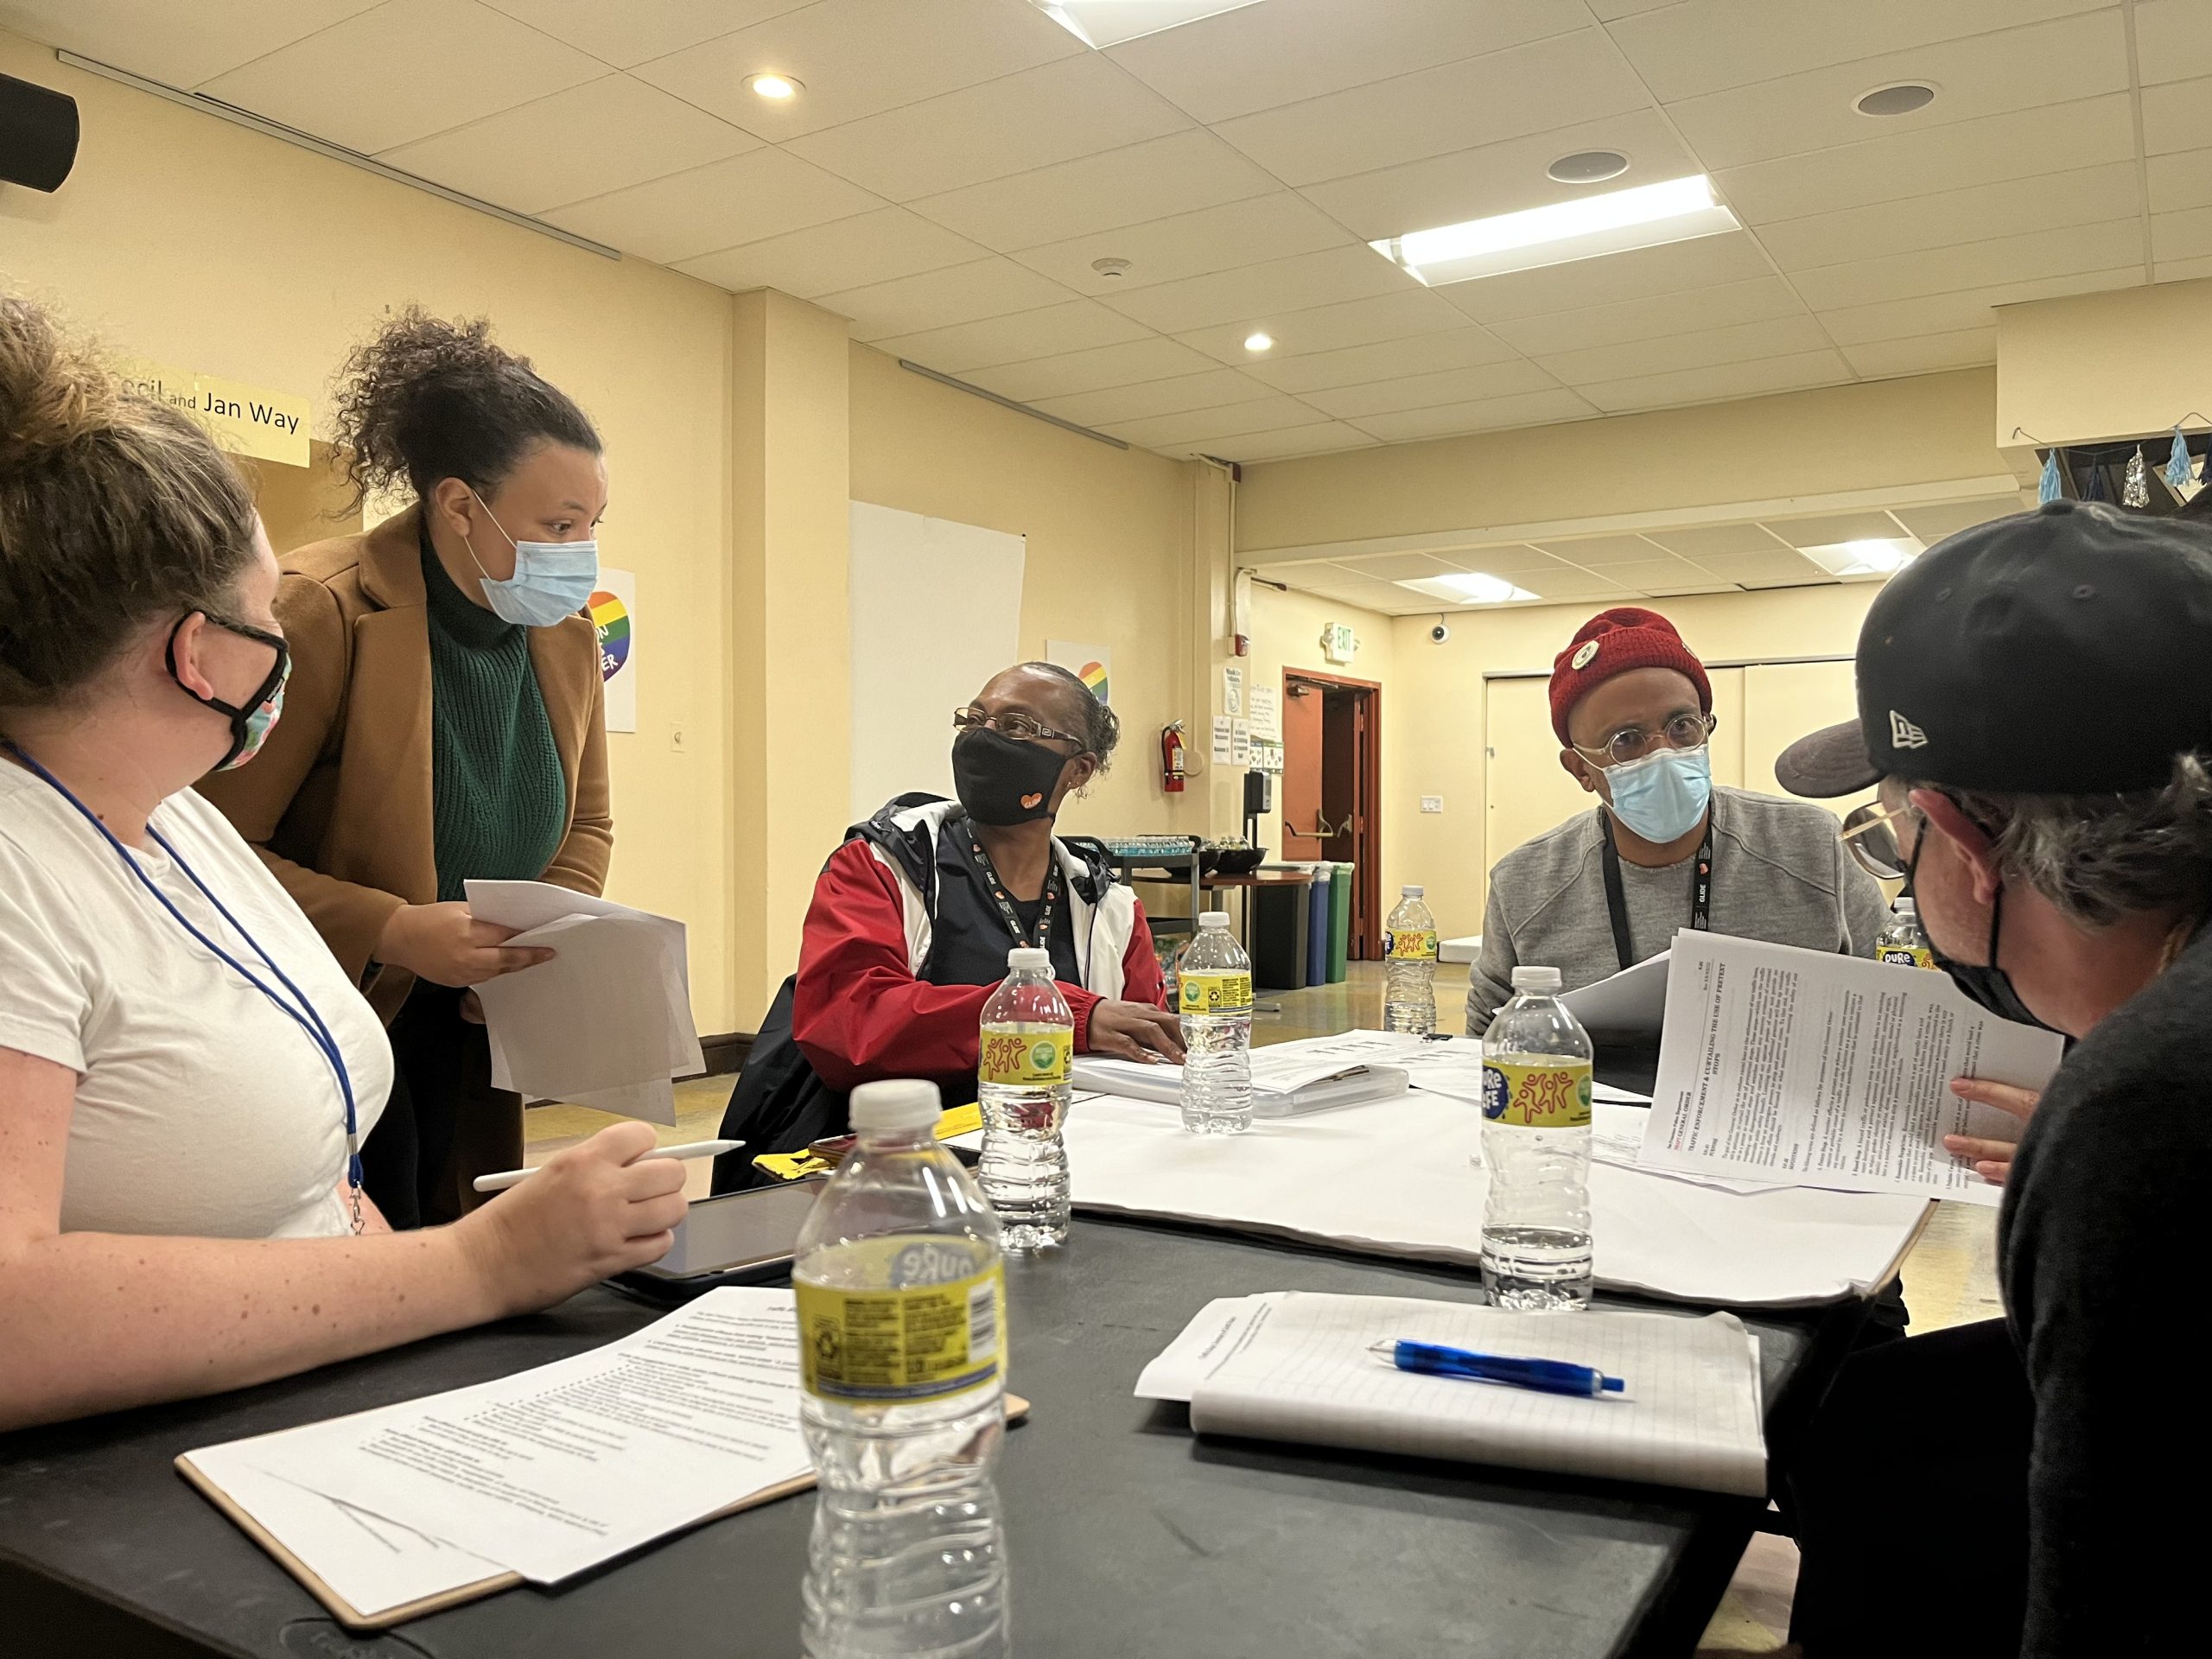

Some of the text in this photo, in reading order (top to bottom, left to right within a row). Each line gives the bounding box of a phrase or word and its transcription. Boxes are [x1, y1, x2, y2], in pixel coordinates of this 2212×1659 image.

[120, 379, 299, 435] ecil and Jan Way
[1337, 626, 1351, 651] EXIT
[1716, 962, 1726, 993] PRETEXT
[1714, 994, 1721, 1003] OF
[1704, 1033, 1716, 1075] CURTAILING
[1682, 1090, 1692, 1112] ORDER
[1693, 1082, 1708, 1130] ENFORCEMENT
[1678, 1112, 1688, 1137] GENERAL
[1688, 1129, 1699, 1151] TRAFFIC
